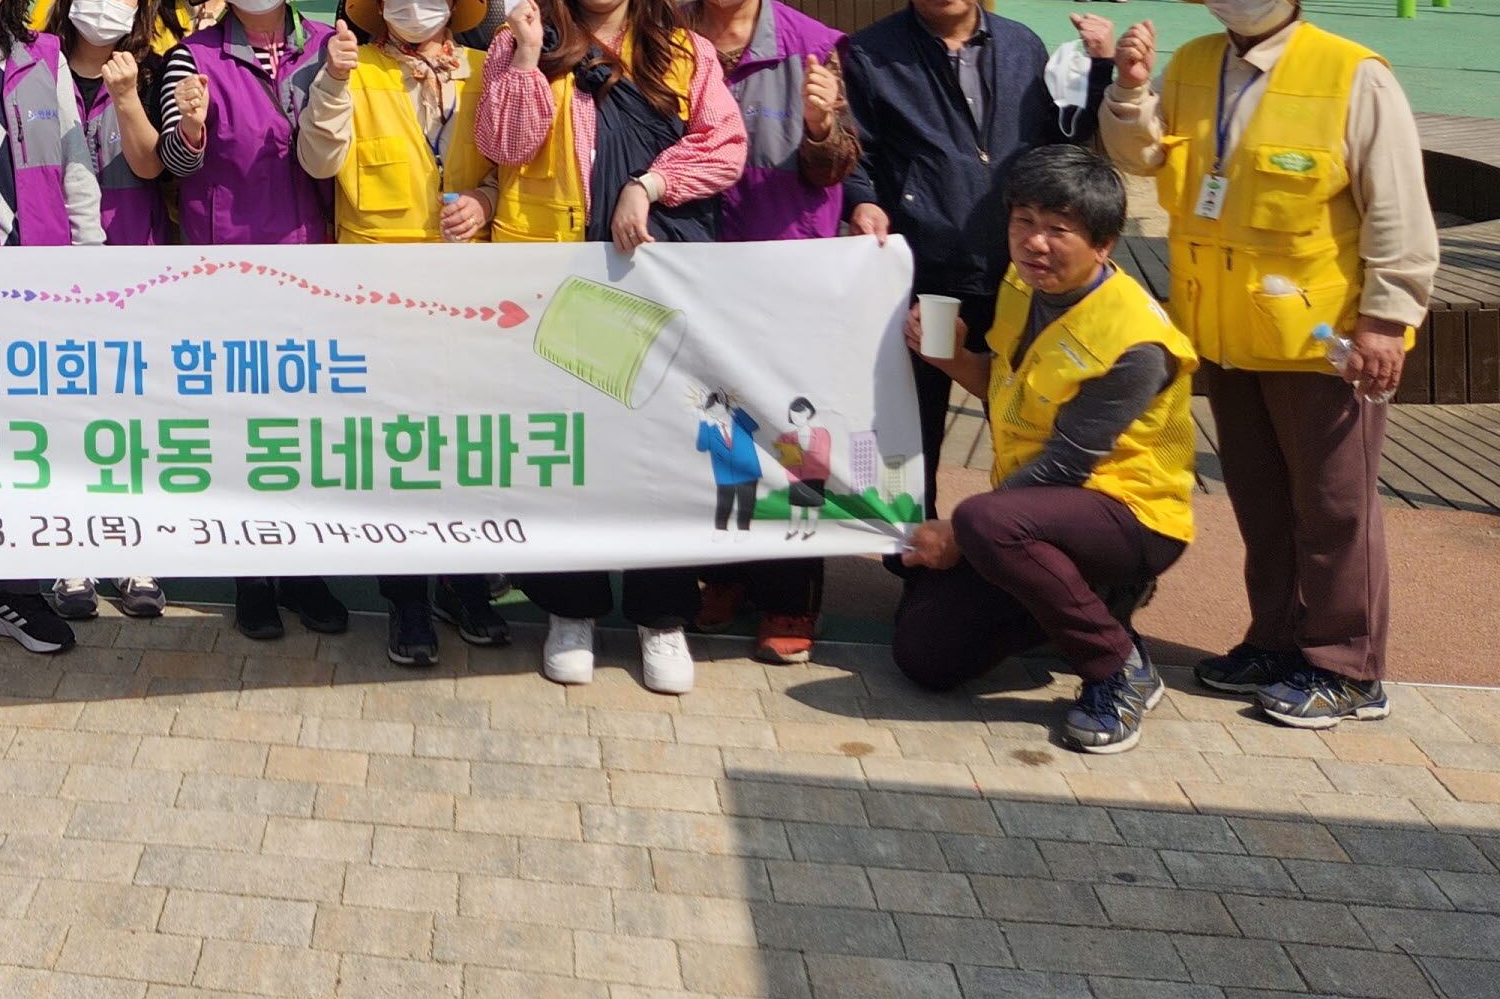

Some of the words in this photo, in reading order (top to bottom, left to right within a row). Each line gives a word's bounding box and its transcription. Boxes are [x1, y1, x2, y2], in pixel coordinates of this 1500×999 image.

[171, 339, 368, 396] 함께하는
[84, 418, 213, 494] 와동
[245, 412, 587, 491] 동네한바퀴
[29, 516, 143, 548] 23.(목)
[192, 518, 297, 546] 31.(금)
[306, 518, 527, 545] 14:00~16:00
